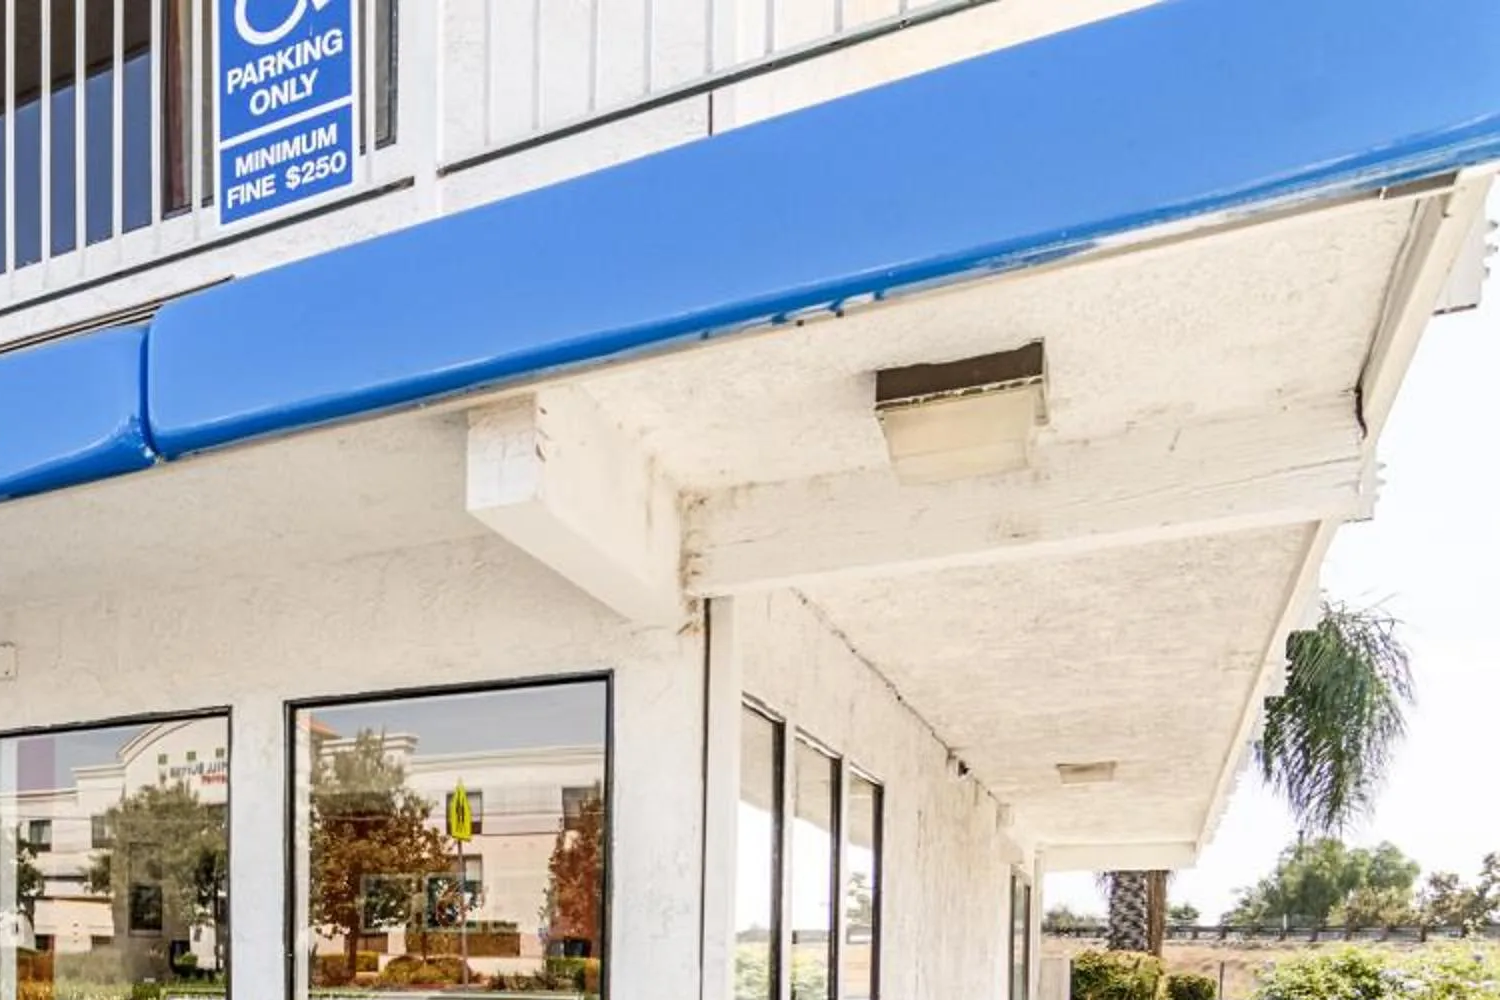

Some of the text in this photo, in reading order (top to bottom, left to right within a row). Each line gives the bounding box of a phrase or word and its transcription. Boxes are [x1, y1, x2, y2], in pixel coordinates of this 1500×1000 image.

[227, 28, 343, 95] PARKING
[249, 68, 319, 116] ONLY
[235, 123, 338, 178] MINIMUM
[227, 150, 347, 209] FINE $250
